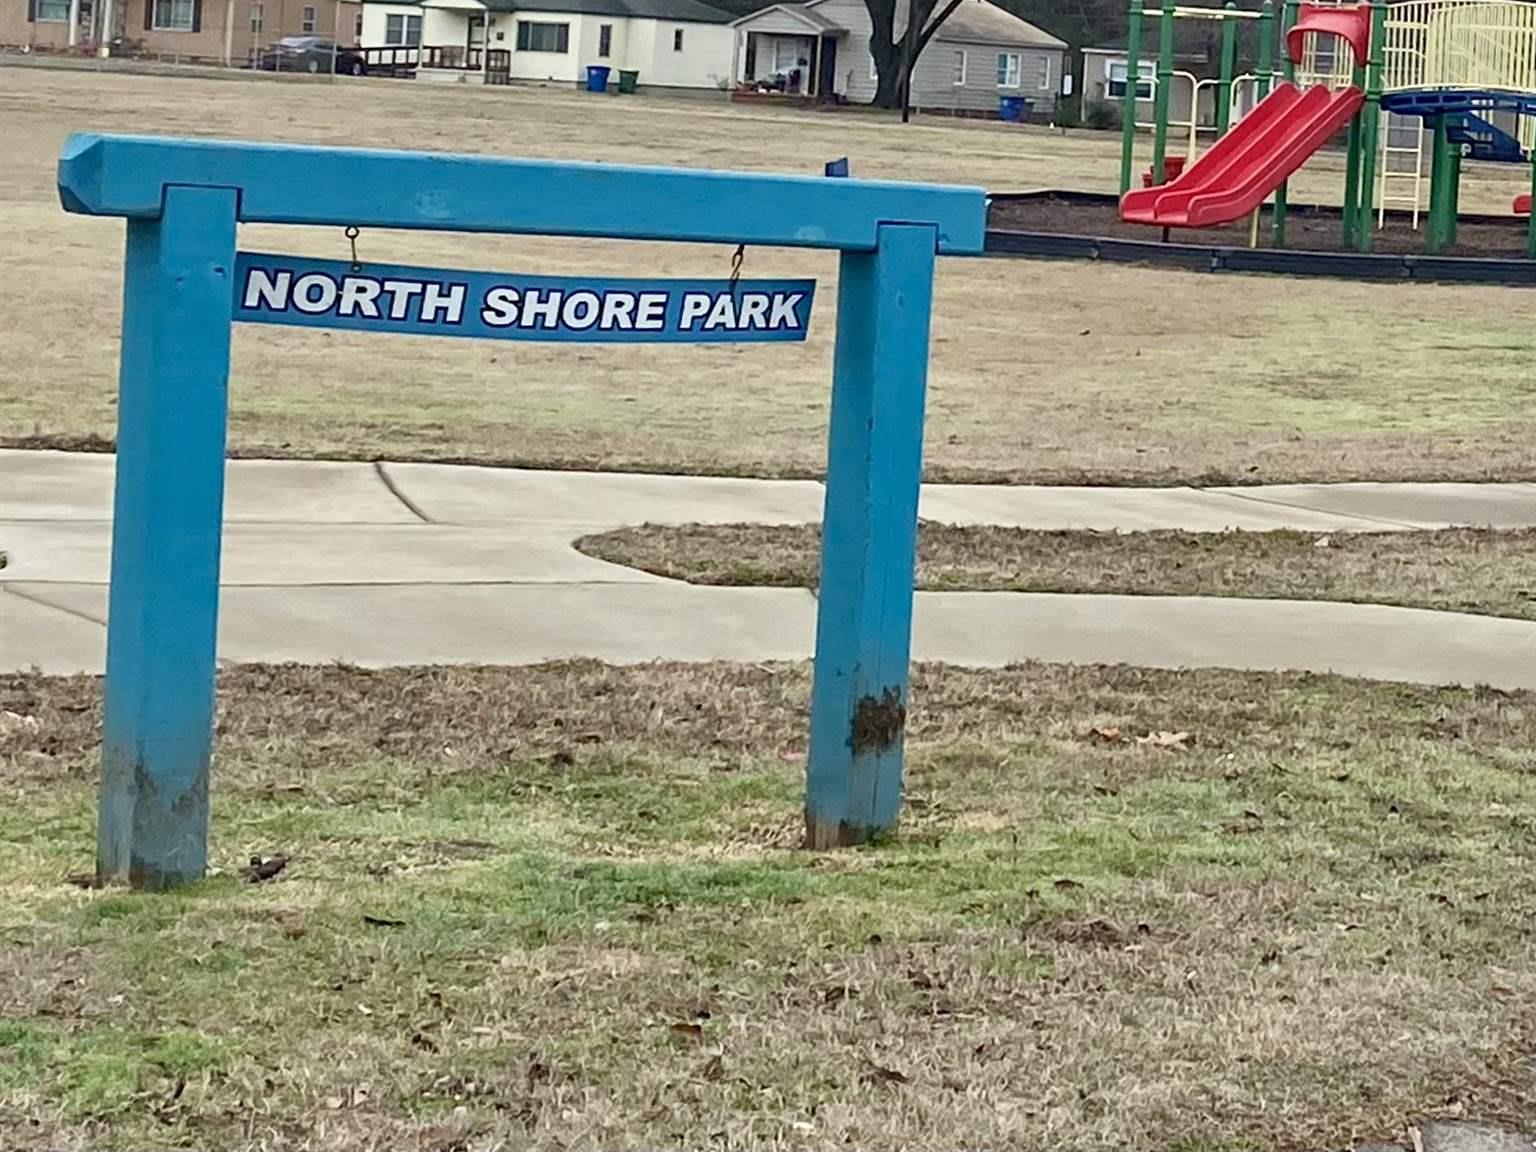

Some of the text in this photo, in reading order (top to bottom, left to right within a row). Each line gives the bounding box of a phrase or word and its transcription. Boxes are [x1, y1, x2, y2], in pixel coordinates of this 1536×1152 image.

[243, 269, 804, 330] NORTH SHORE PARK
